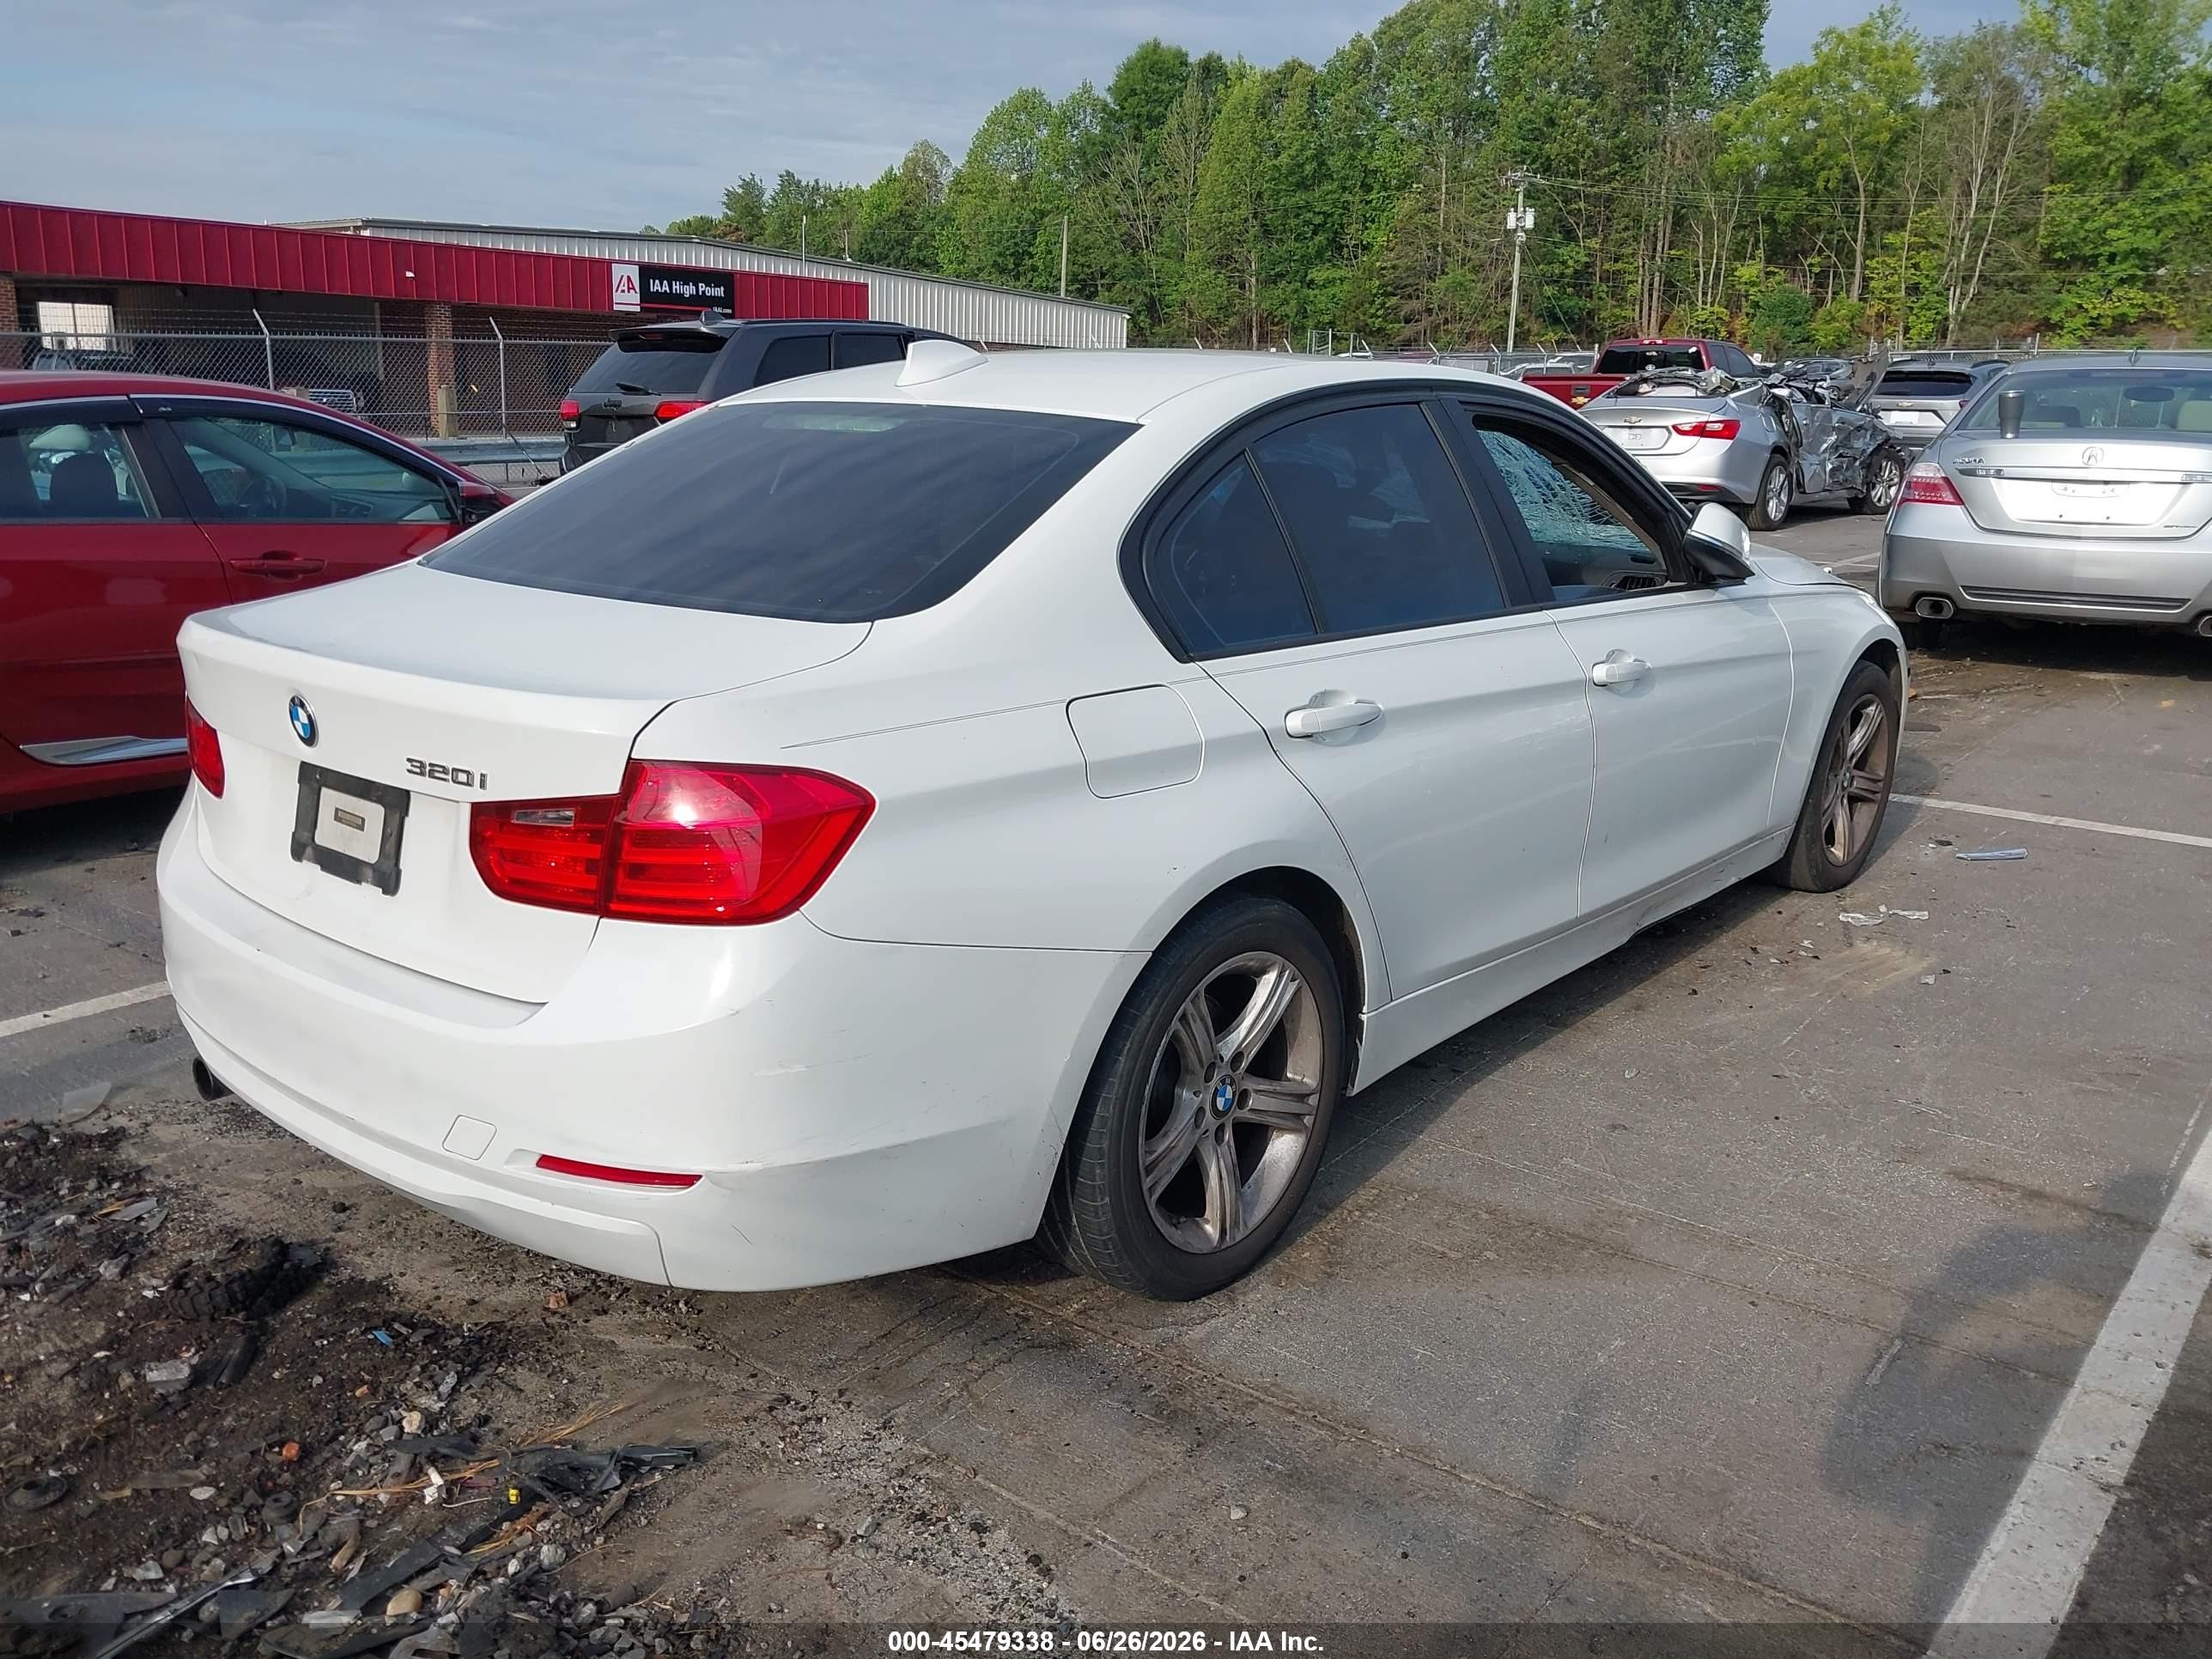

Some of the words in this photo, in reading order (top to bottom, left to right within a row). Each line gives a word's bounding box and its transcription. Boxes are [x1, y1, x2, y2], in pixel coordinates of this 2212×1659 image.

[649, 278, 670, 293] IAA
[672, 280, 696, 298] High
[698, 283, 725, 297] Point
[405, 757, 489, 791] 320i
